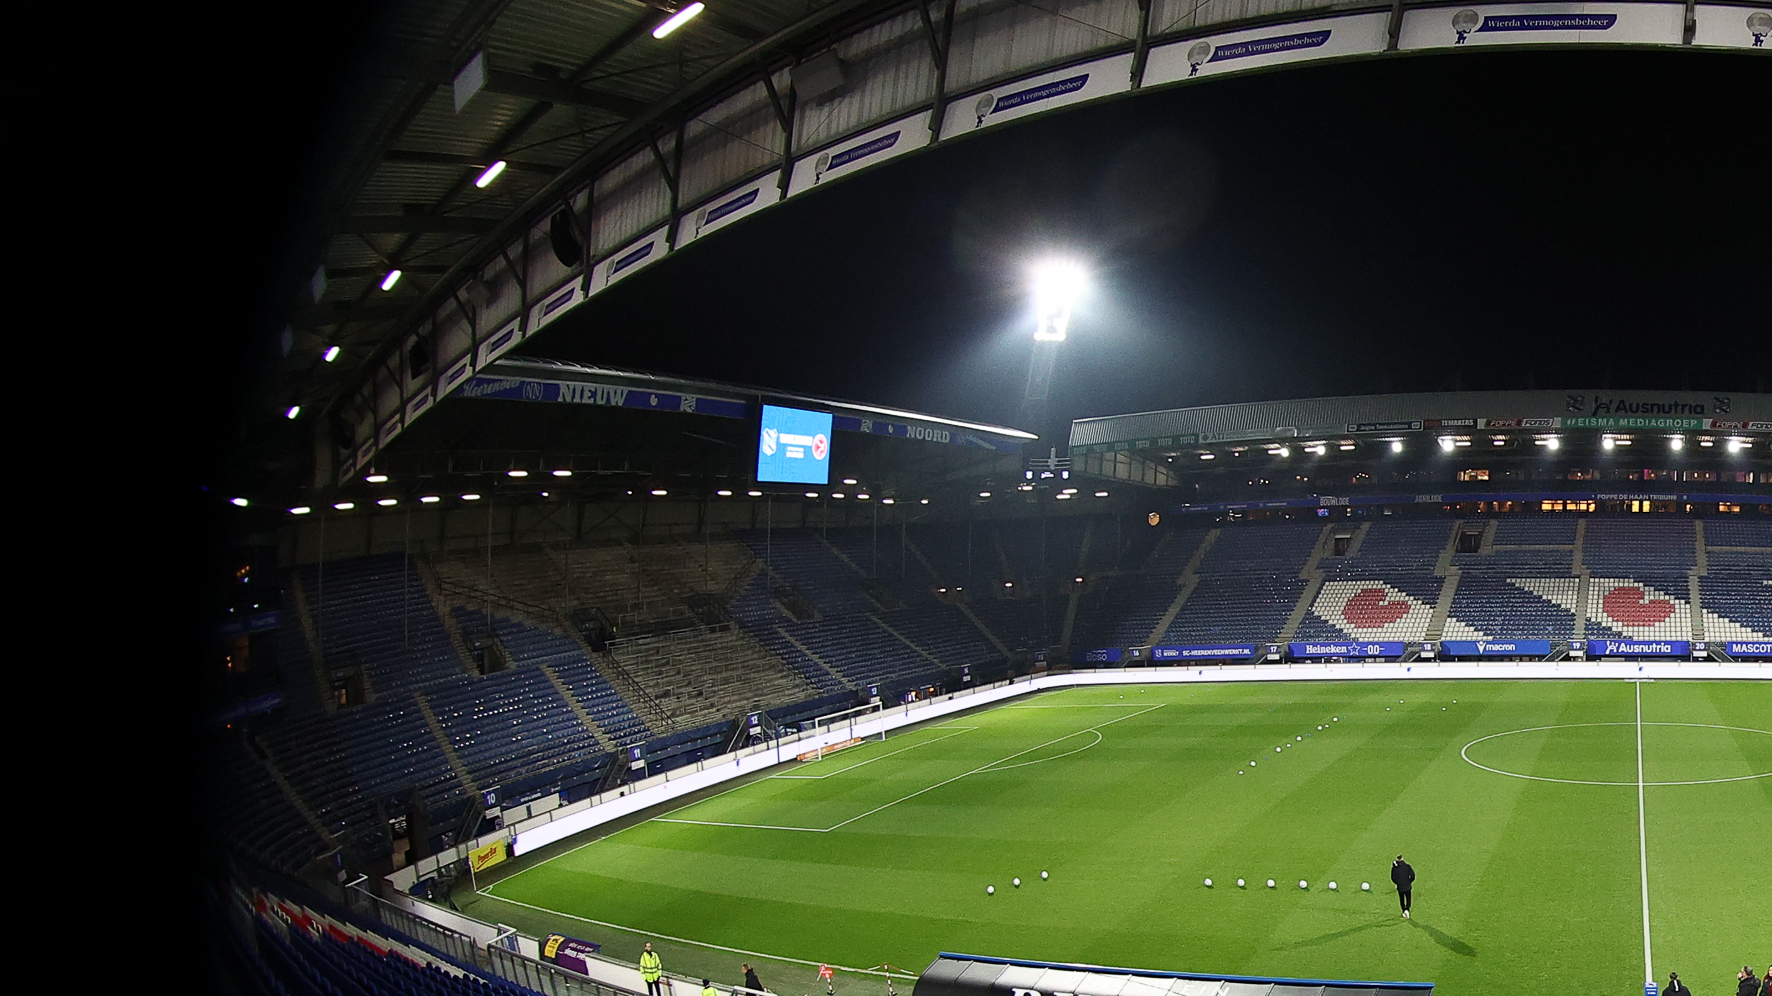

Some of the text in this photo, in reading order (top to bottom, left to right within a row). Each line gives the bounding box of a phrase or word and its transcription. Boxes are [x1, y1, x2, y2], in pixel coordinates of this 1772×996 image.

[1488, 18, 1608, 28] Wierda Vermogensbeheer
[1217, 36, 1323, 57] Wierda Vermogensbeheer
[998, 80, 1083, 107] Wierda Vermogensbeheer
[557, 383, 630, 407] NIEUW
[1615, 400, 1705, 415] Ausnutria
[1524, 419, 1551, 427] FONDS
[1578, 418, 1698, 428] EISMA MEDIAGROEP
[1715, 421, 1742, 429] FOPPE
[906, 425, 950, 443] NOORD
[1306, 644, 1347, 655] Heineken
[1486, 642, 1516, 651] macron
[1618, 642, 1671, 653] Ausnutria
[751, 715, 758, 724] 12
[634, 748, 641, 758] 11
[487, 793, 495, 804] 10
